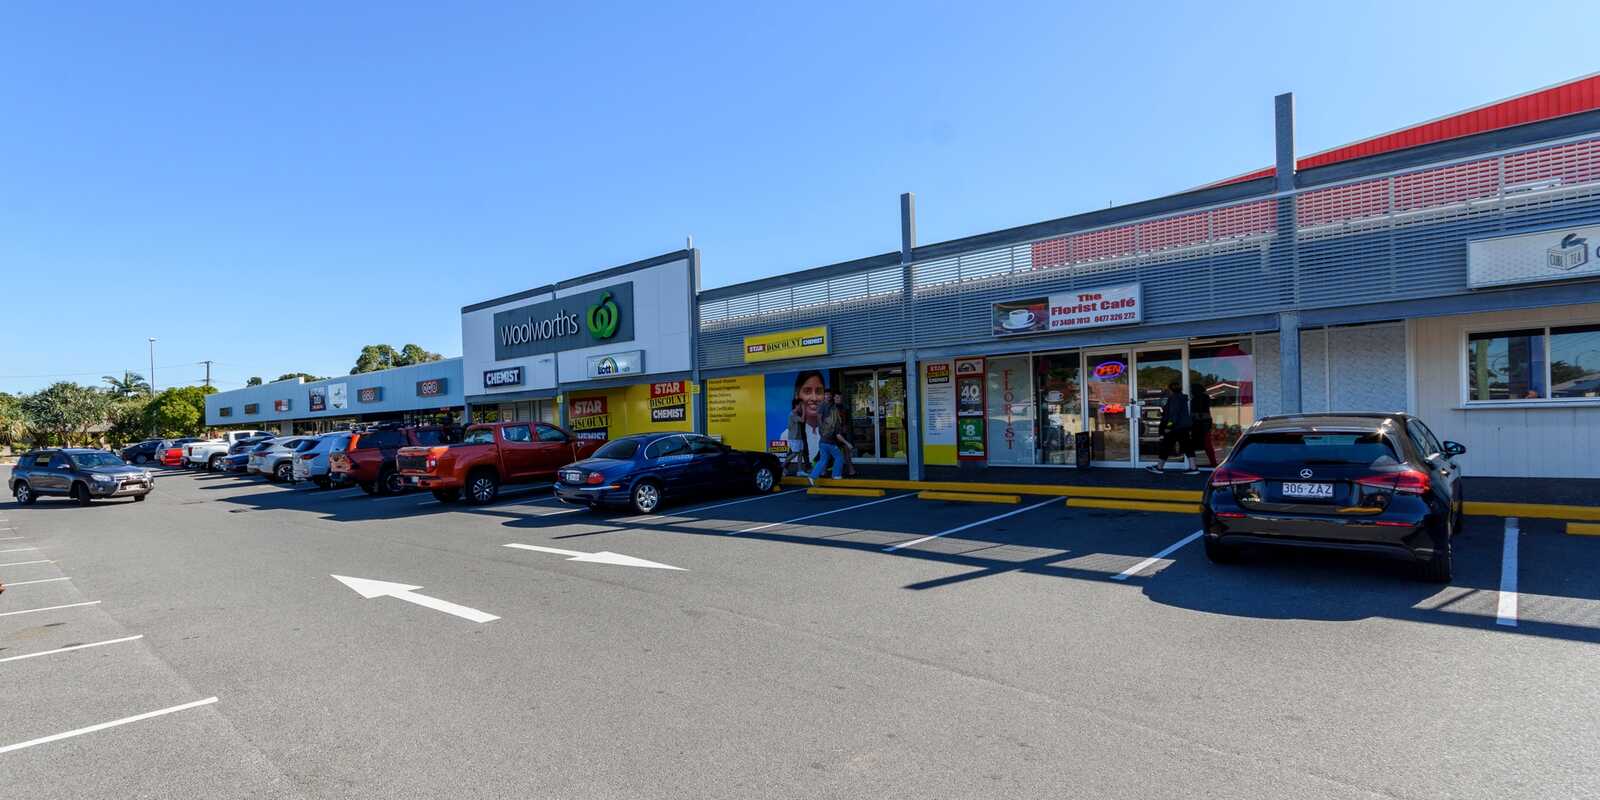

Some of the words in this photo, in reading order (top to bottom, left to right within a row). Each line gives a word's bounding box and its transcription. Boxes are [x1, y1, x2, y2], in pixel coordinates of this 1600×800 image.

[1077, 293, 1102, 302] The
[1051, 303, 1097, 316] Florist
[1100, 297, 1136, 310] Café
[500, 308, 578, 346] Woolworths
[1096, 364, 1121, 376] OPEN
[486, 369, 519, 385] CHEMIST
[655, 381, 680, 394] STAR
[575, 399, 602, 414] STAR
[650, 395, 687, 408] DISCOUNT
[652, 407, 684, 419] CHEMIST
[1003, 369, 1015, 449] FLORIST
[1283, 483, 1303, 494] 306
[1308, 484, 1332, 494] ZAZ
